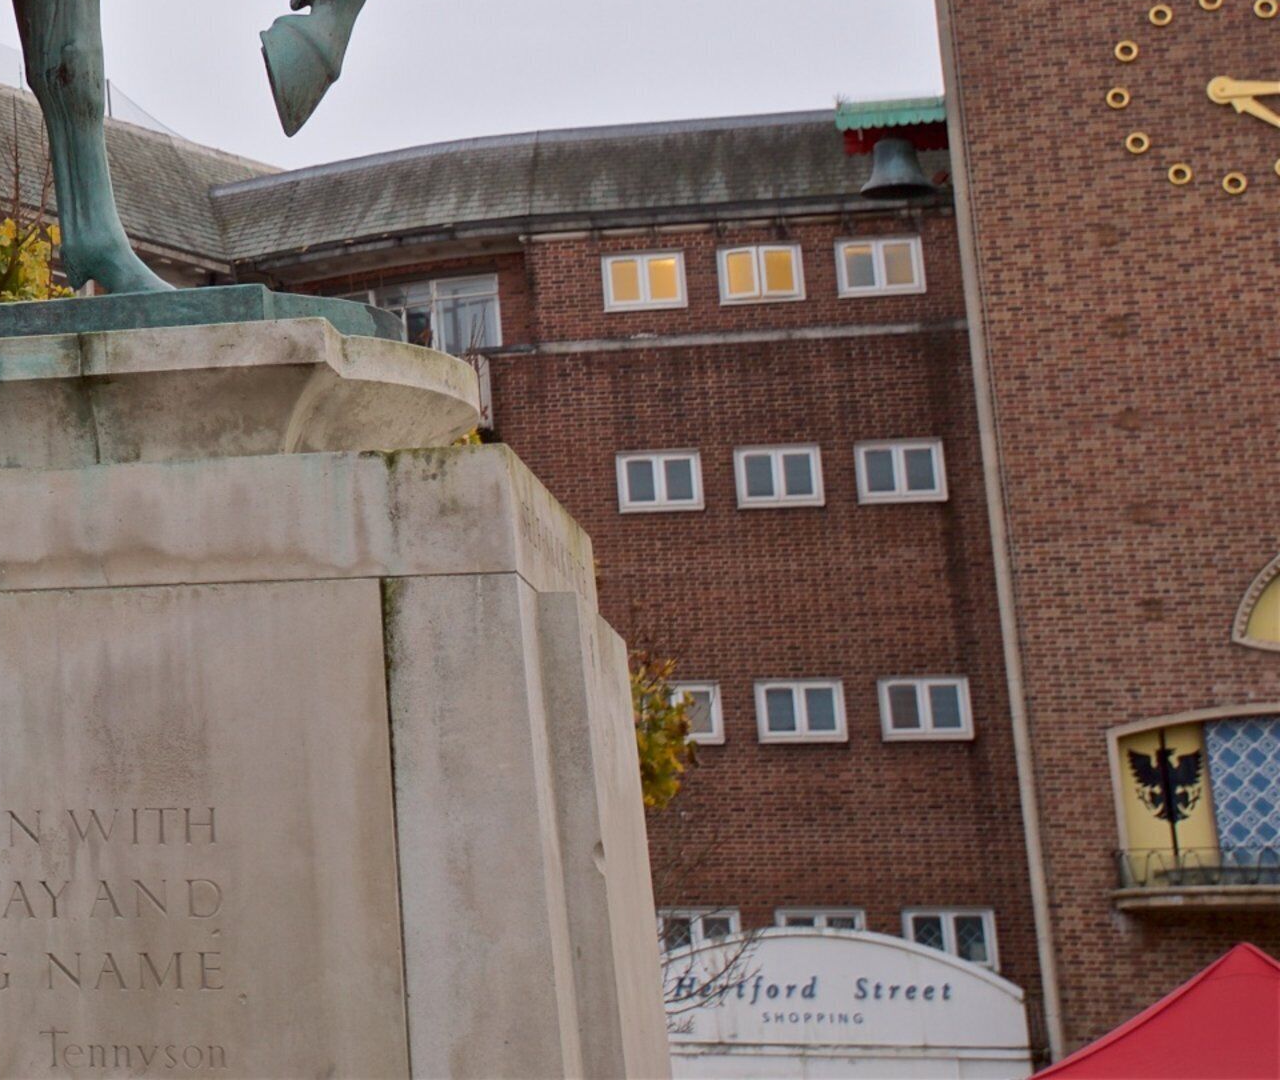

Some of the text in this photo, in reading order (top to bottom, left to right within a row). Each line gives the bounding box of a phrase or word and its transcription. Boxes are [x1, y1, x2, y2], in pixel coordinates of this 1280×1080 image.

[67, 806, 218, 847] WITH
[88, 877, 224, 919] AND
[46, 951, 225, 992] NAME
[673, 974, 953, 1005] Hertford Street
[762, 1012, 865, 1025] SHOPPING
[39, 1026, 229, 1074] Tennyson
